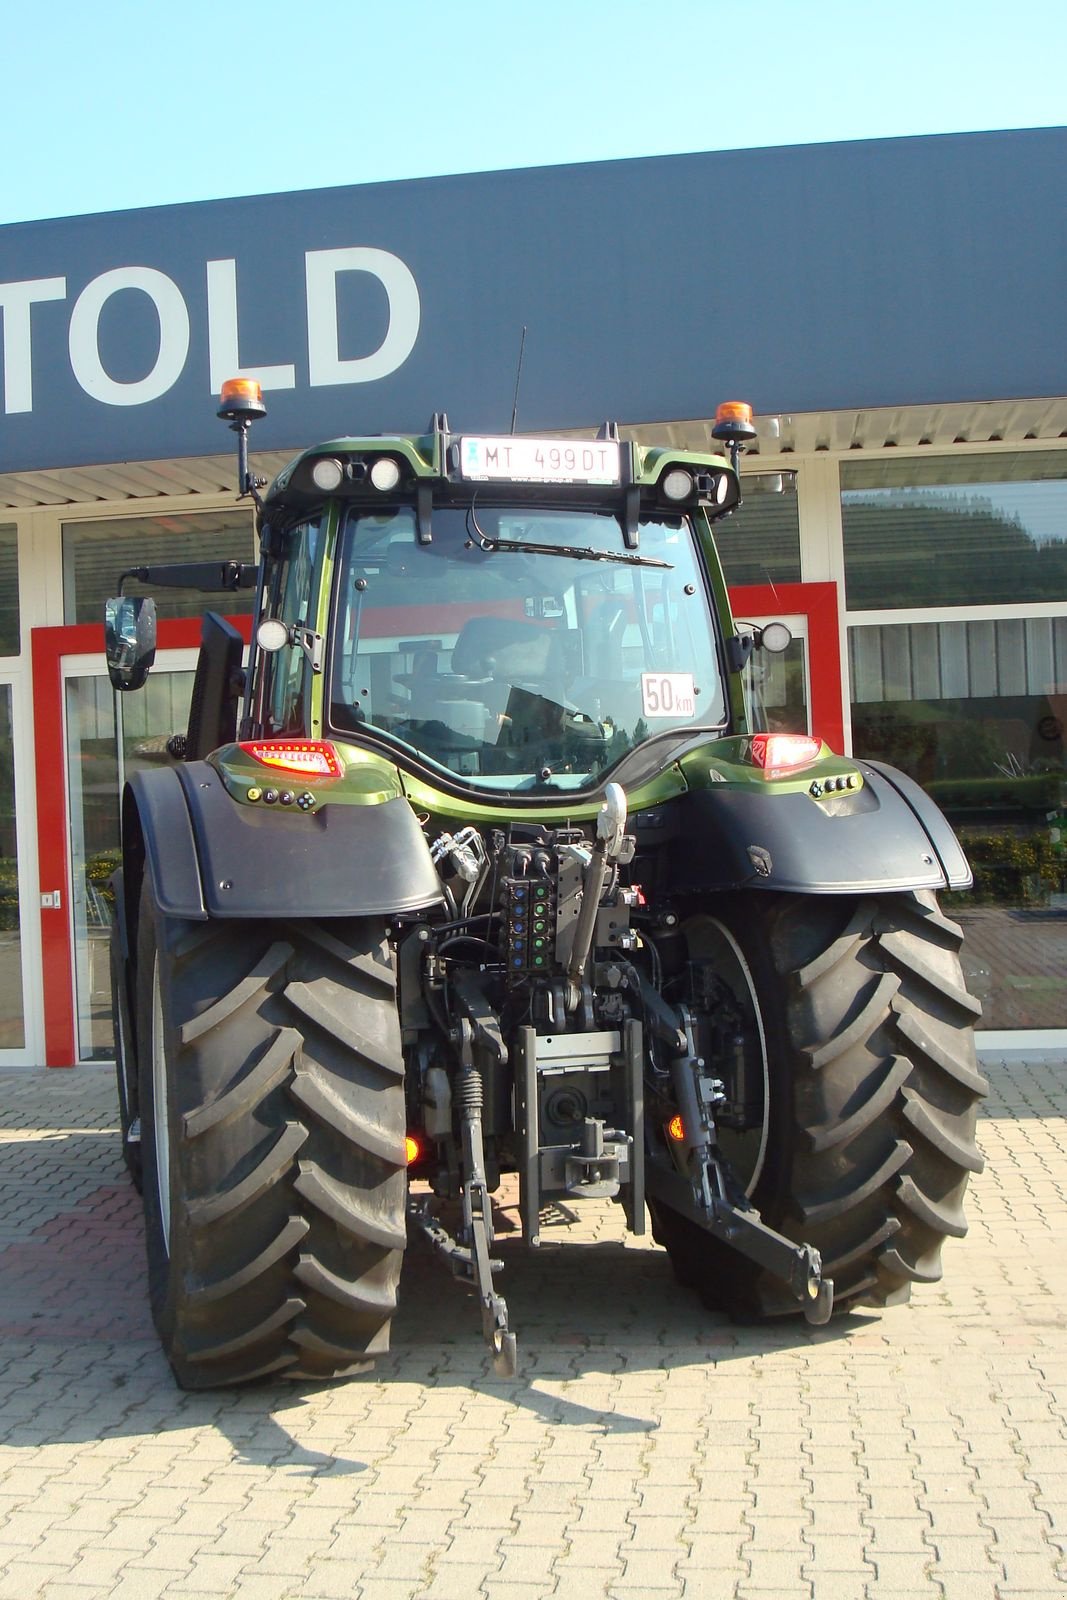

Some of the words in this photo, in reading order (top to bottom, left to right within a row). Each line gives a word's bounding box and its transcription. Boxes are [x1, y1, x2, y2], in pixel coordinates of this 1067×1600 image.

[0, 247, 420, 414] TOLD
[485, 446, 513, 468] MT
[645, 678, 673, 711] 50
[675, 694, 693, 711] km
